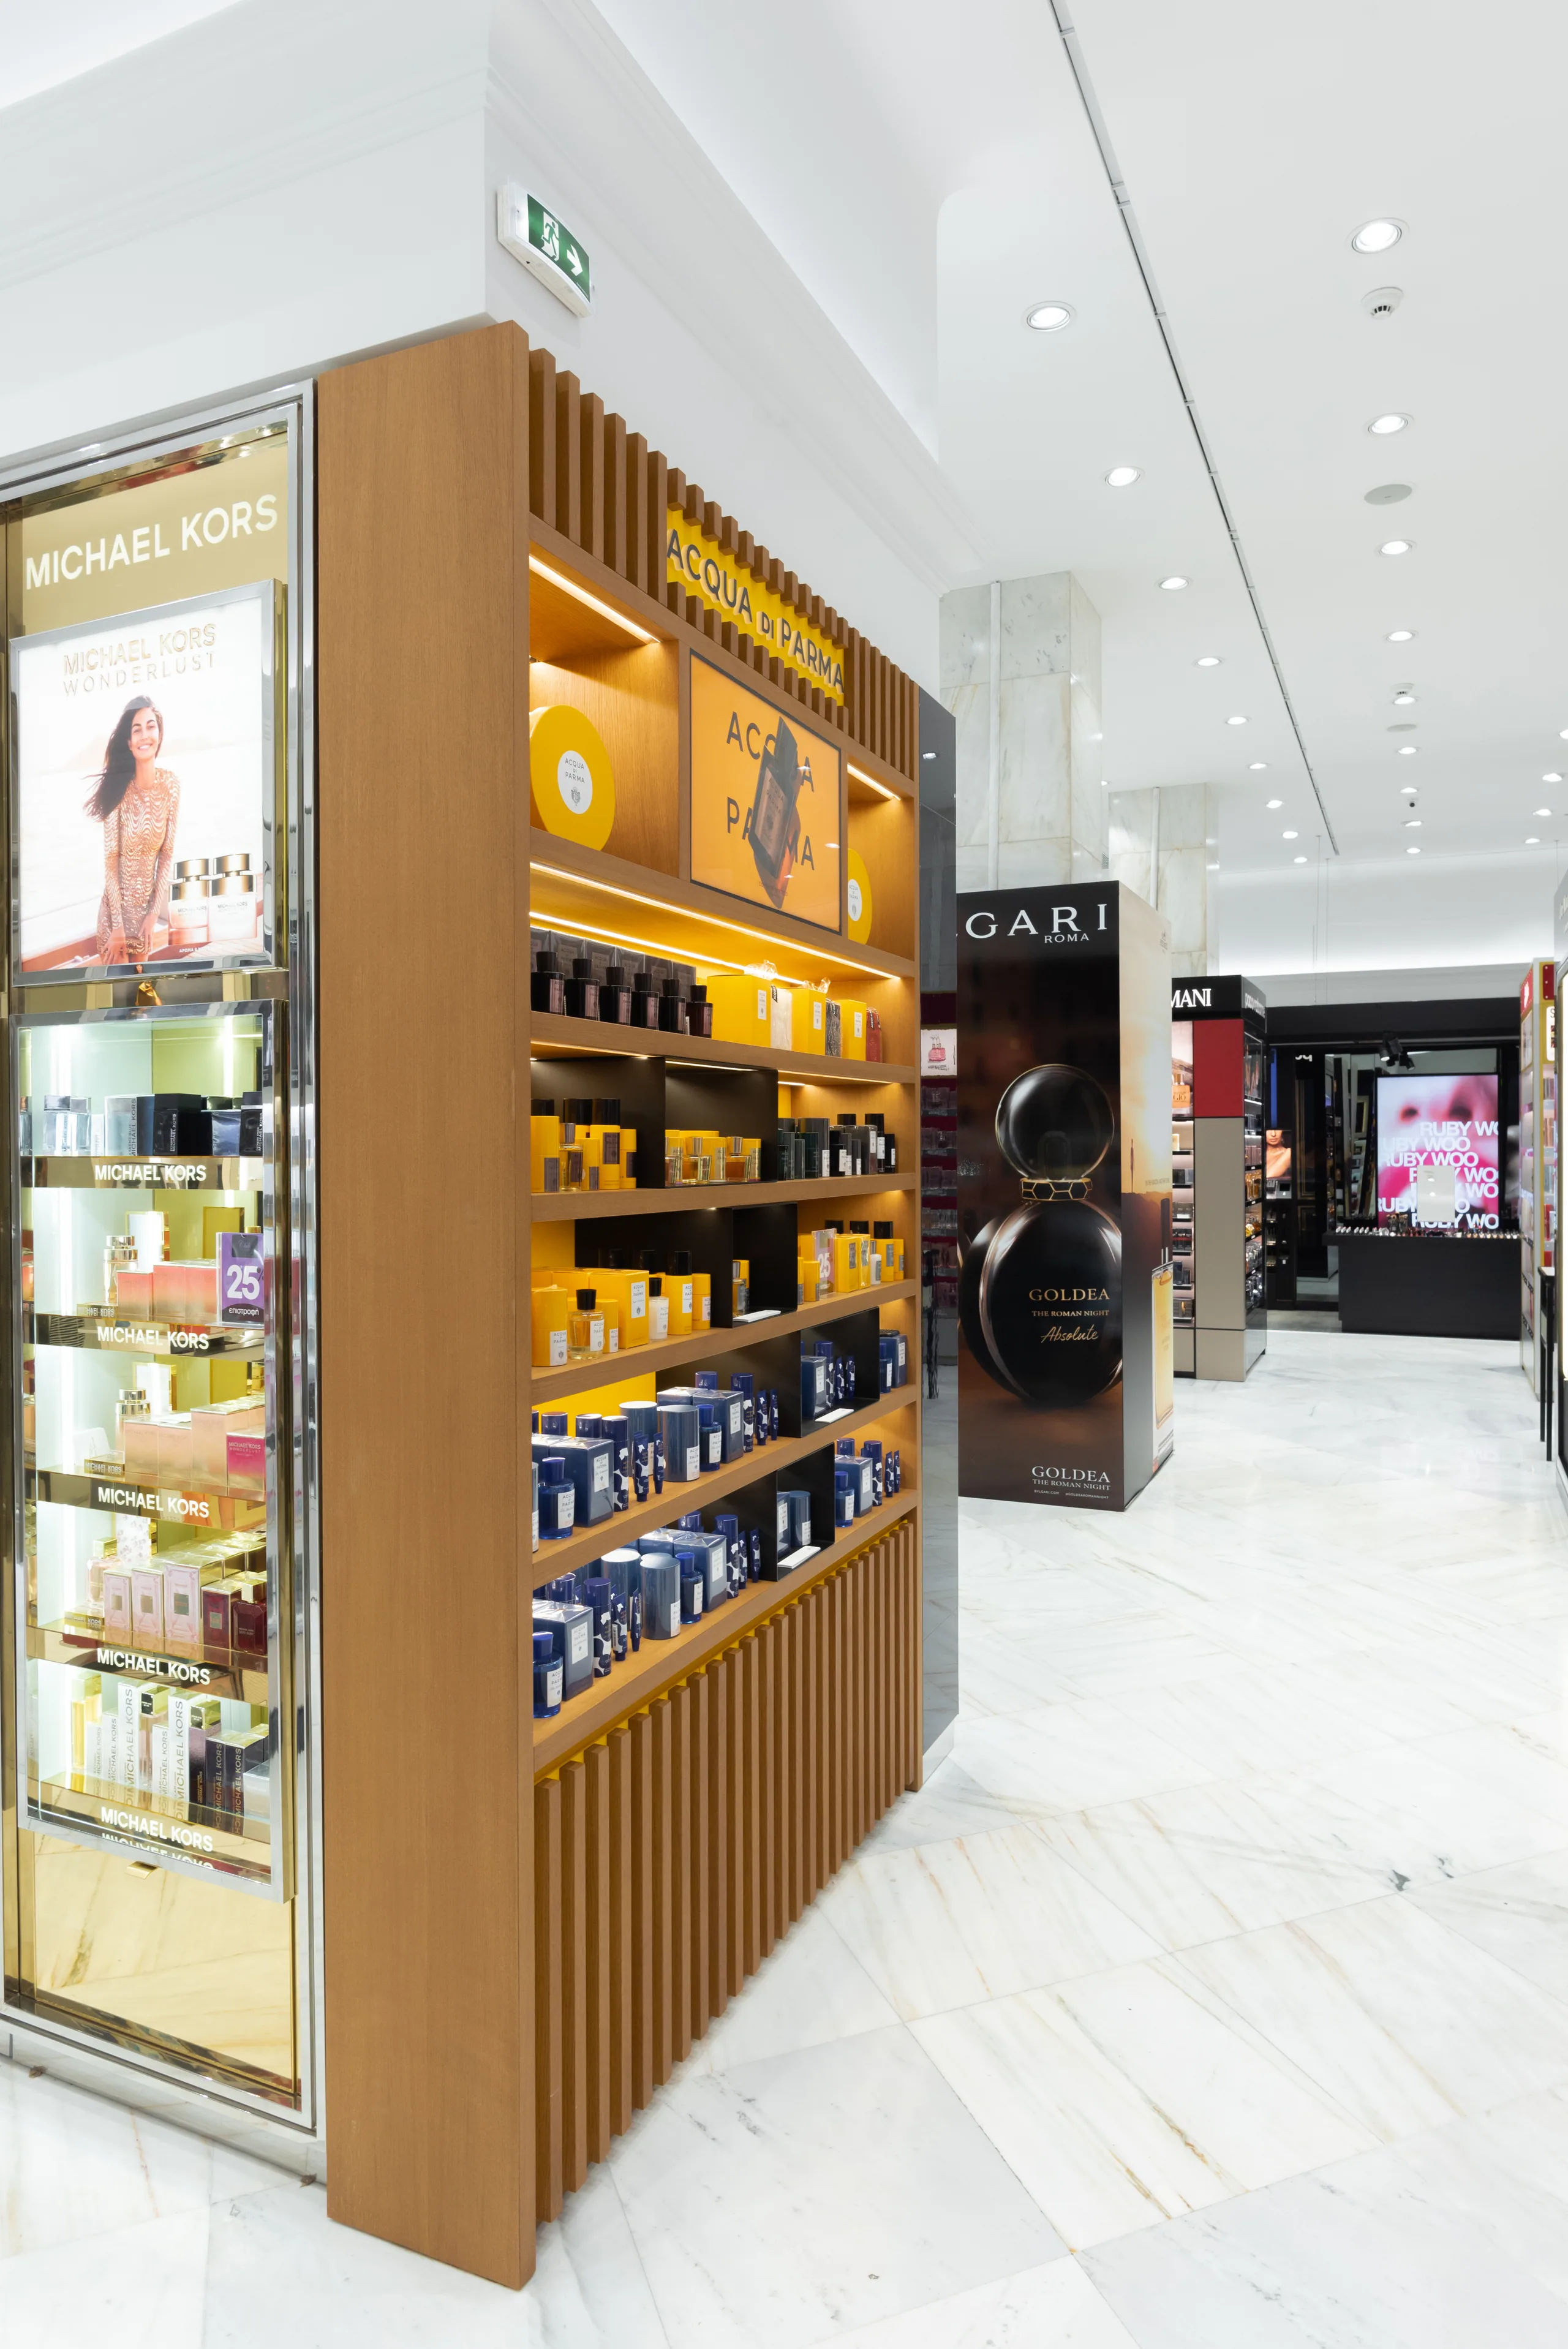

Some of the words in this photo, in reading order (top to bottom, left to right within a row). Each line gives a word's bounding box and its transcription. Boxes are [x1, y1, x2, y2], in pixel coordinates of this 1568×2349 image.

[26, 524, 170, 590] MICHAEL
[182, 494, 277, 551] KORS
[667, 529, 753, 623] ACQUA
[760, 611, 774, 639] DI
[778, 617, 843, 694] PARMA
[64, 639, 151, 676] MICHAEL
[159, 624, 216, 655] KORS
[63, 651, 216, 697] WONDERLUST
[726, 712, 814, 792] ACA
[565, 758, 584, 769] ACQUA
[565, 772, 585, 783] PARMA
[727, 796, 815, 870] PAMA
[957, 903, 1107, 938] GARI
[1044, 933, 1090, 943] ROMA
[1420, 1121, 1472, 1136] RUBY
[1423, 1137, 1471, 1152] WOO
[1431, 1152, 1479, 1167] WOO
[95, 1165, 160, 1181] MICHAEL
[165, 1165, 206, 1181] KORS
[1464, 1167, 1498, 1182] WO
[1465, 1183, 1499, 1198] WO
[1466, 1213, 1499, 1229] WO
[817, 1253, 831, 1278] 25
[1029, 1288, 1110, 1301] GOLDEA
[229, 1308, 259, 1316] επιστροφή
[97, 1326, 164, 1346] MICHAEL
[167, 1332, 209, 1349] KORS
[1041, 1324, 1098, 1343] Absolute
[1032, 1466, 1110, 1483] GOLDEA
[98, 1487, 164, 1511] MICHAEL
[168, 1497, 209, 1518] KORS
[97, 1648, 164, 1675] MICHAEL
[168, 1662, 210, 1685] KORS
[101, 1806, 167, 1840] MICHAEL
[171, 1825, 213, 1852] KORS
